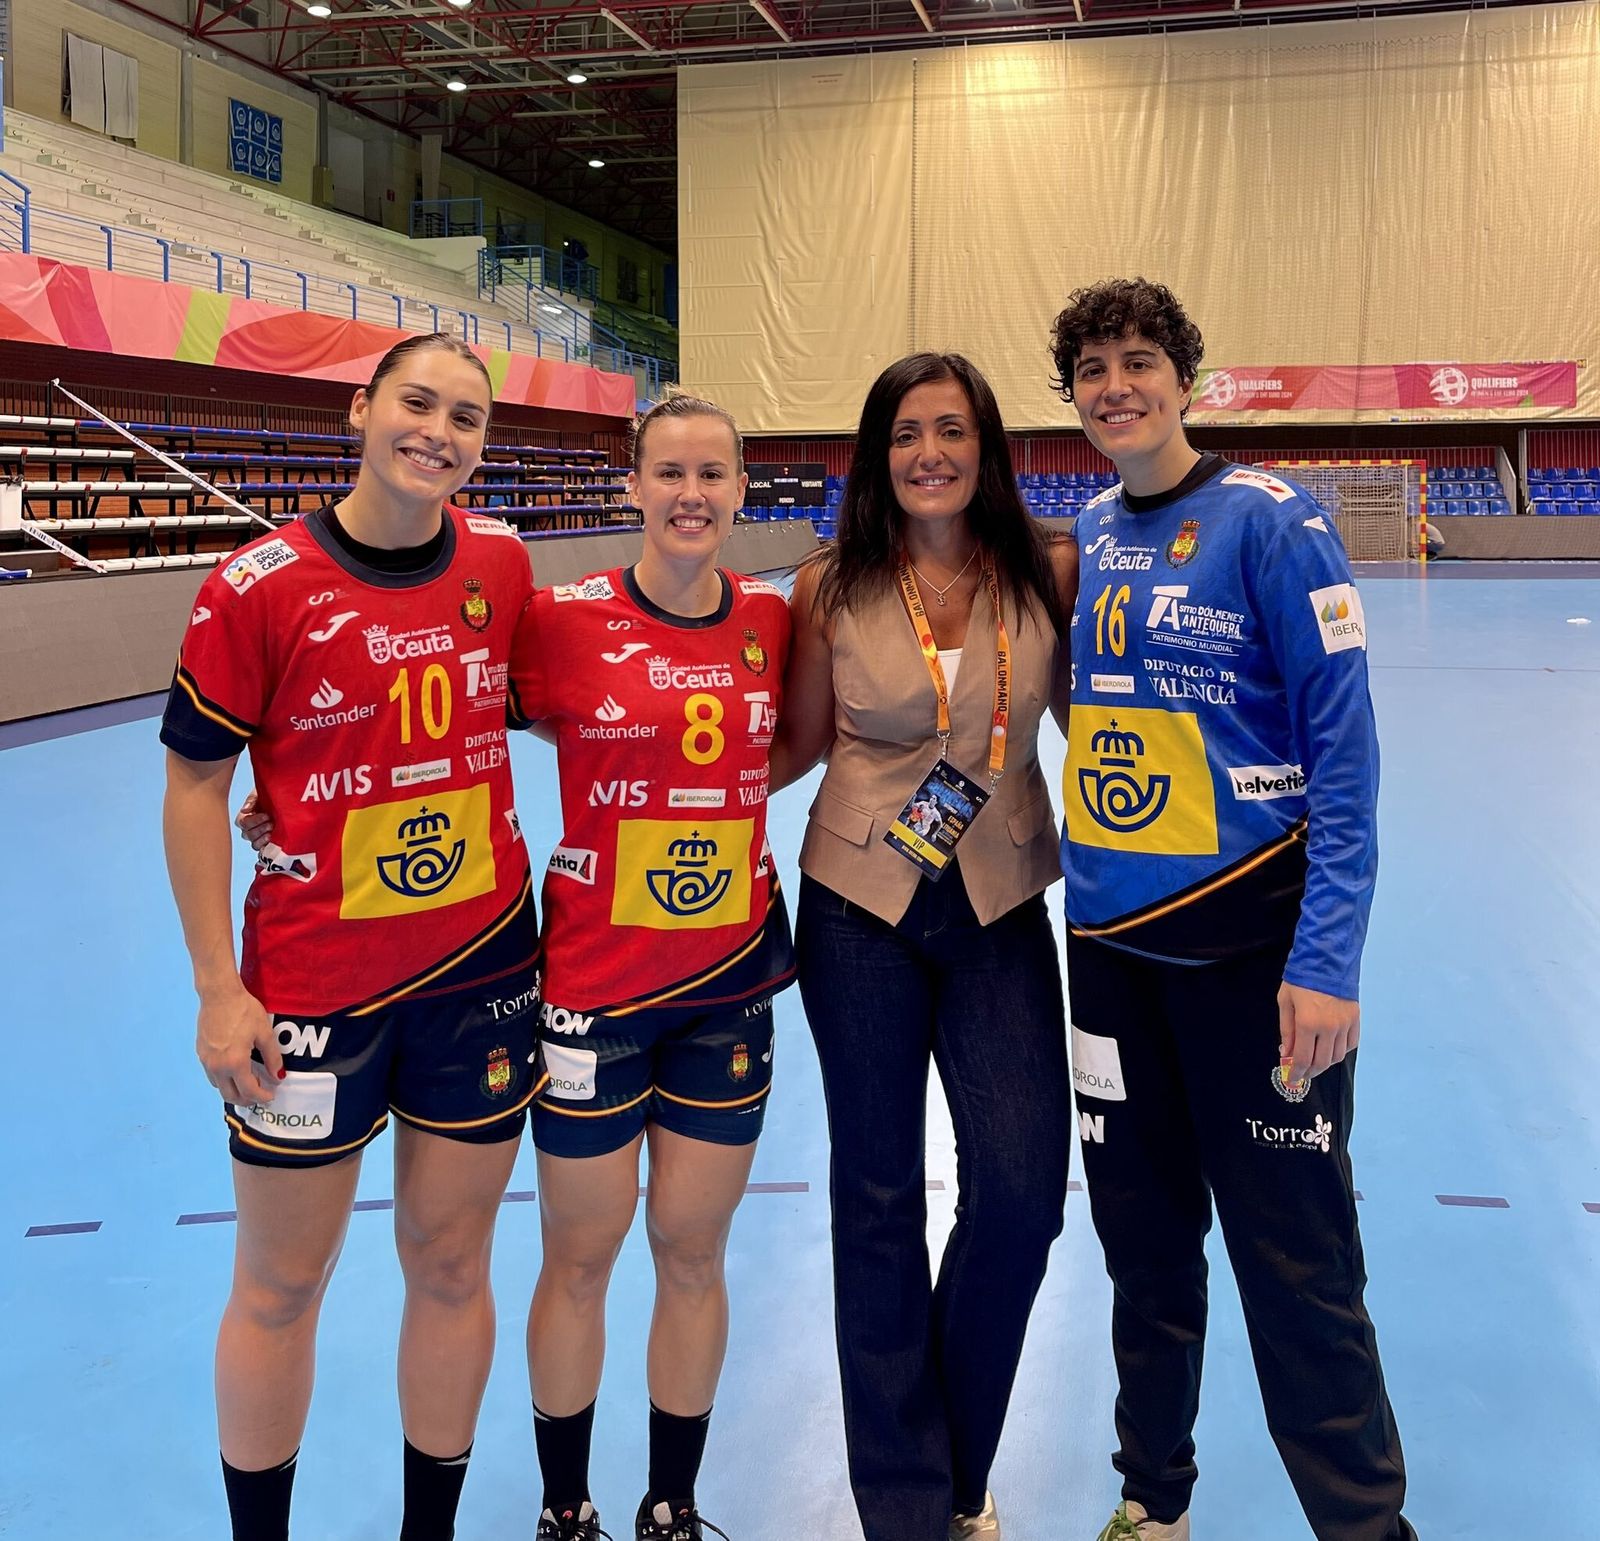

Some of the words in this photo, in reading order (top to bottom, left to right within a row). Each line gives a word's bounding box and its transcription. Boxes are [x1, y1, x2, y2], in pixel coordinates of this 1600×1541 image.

[1239, 379, 1283, 391] QUALIFIERS
[1471, 377, 1518, 389] QUALIFIERS
[749, 481, 772, 489] LOCAL
[252, 542, 287, 559] MELILLA
[256, 548, 284, 565] SPORT
[1109, 551, 1153, 570] Ceuta
[261, 551, 297, 571] CAPITAL
[1093, 584, 1131, 657] 16
[1198, 605, 1245, 624] DÓLMENES
[1182, 616, 1241, 636] ANTEQUERA
[391, 633, 454, 660] Ceuta
[1152, 633, 1197, 647] PATRIMONIO
[1198, 642, 1234, 653] MUNDIAL
[671, 670, 735, 689] Ceuta
[1144, 658, 1215, 678] DIPUTACIÓ
[1220, 671, 1237, 683] DE
[997, 650, 1008, 712] BALONMANO
[1149, 677, 1237, 705] VALÈNCIA
[388, 663, 452, 745] 10
[290, 704, 377, 731] Santander
[578, 723, 659, 739] Santander
[681, 692, 725, 765] 8
[300, 764, 372, 802] AVIS
[913, 837, 926, 850] VIP
[270, 1016, 332, 1058] ON
